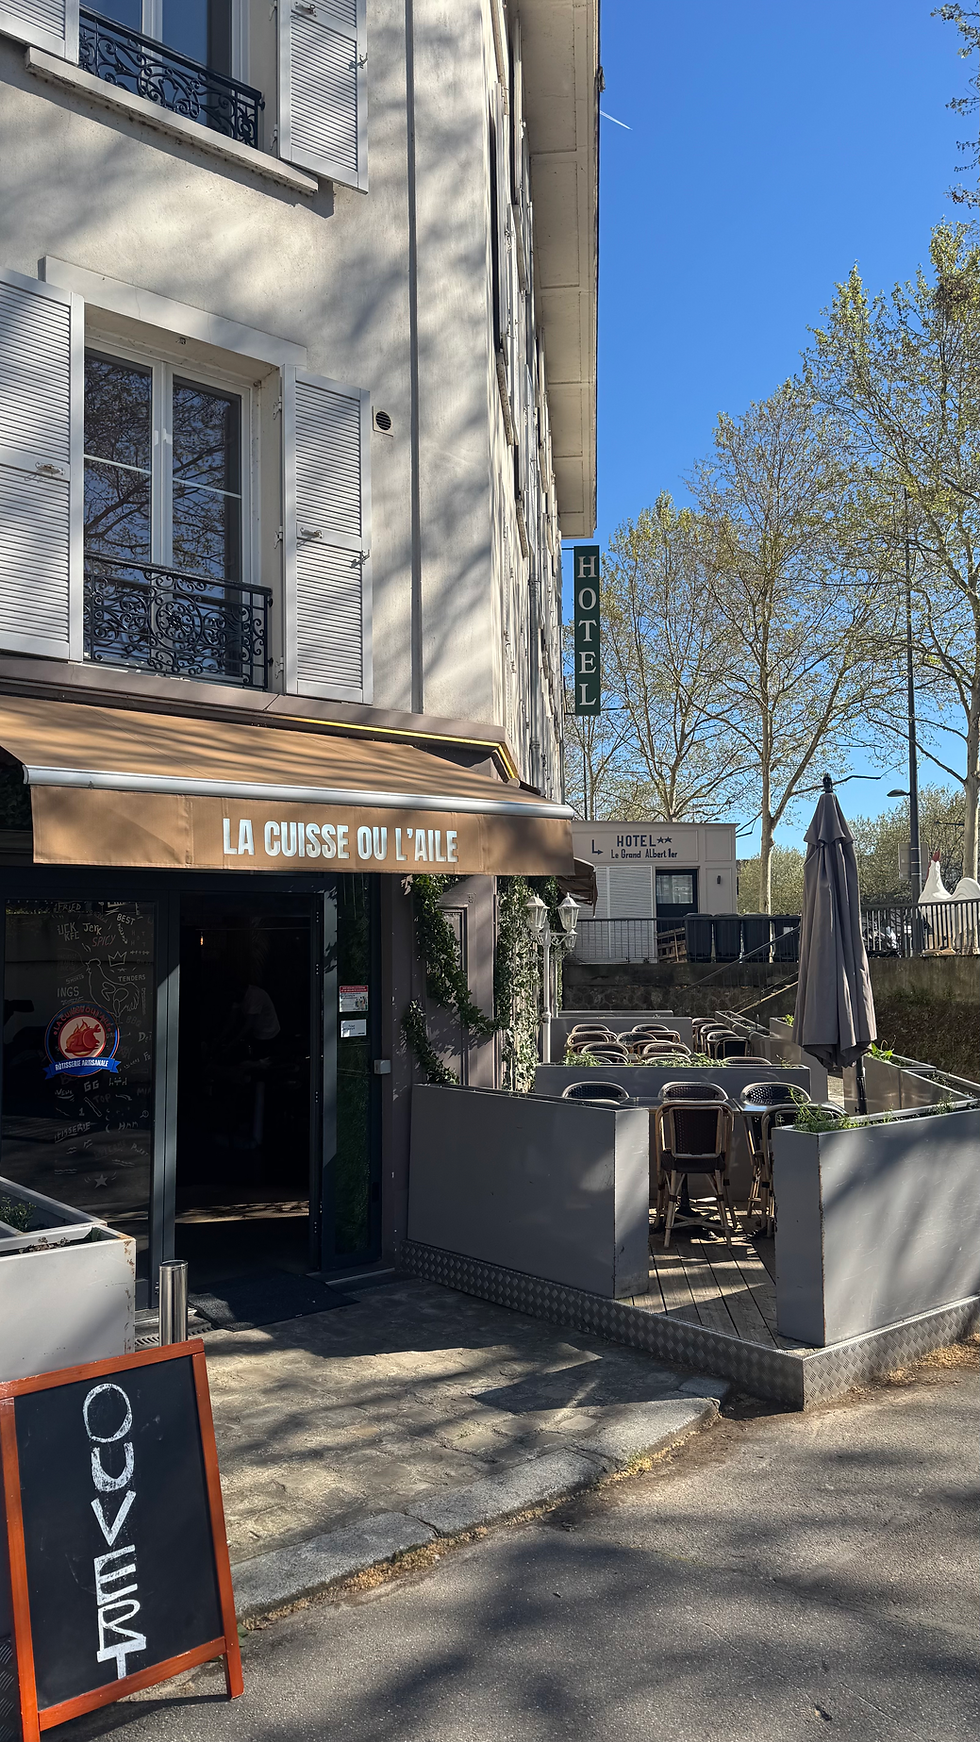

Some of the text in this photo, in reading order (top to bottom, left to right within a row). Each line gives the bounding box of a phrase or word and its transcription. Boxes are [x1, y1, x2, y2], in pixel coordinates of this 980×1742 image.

[577, 556, 597, 706] HOTEL
[222, 817, 458, 863] LA CUISSE OU L'AILE
[616, 834, 657, 848] HOTEL
[610, 848, 619, 859] Le
[620, 848, 642, 859] Grand
[116, 913, 136, 926] BEST
[91, 934, 117, 947] SPICY
[117, 973, 146, 982] TENDERS
[82, 1383, 147, 1680] OUVERT
